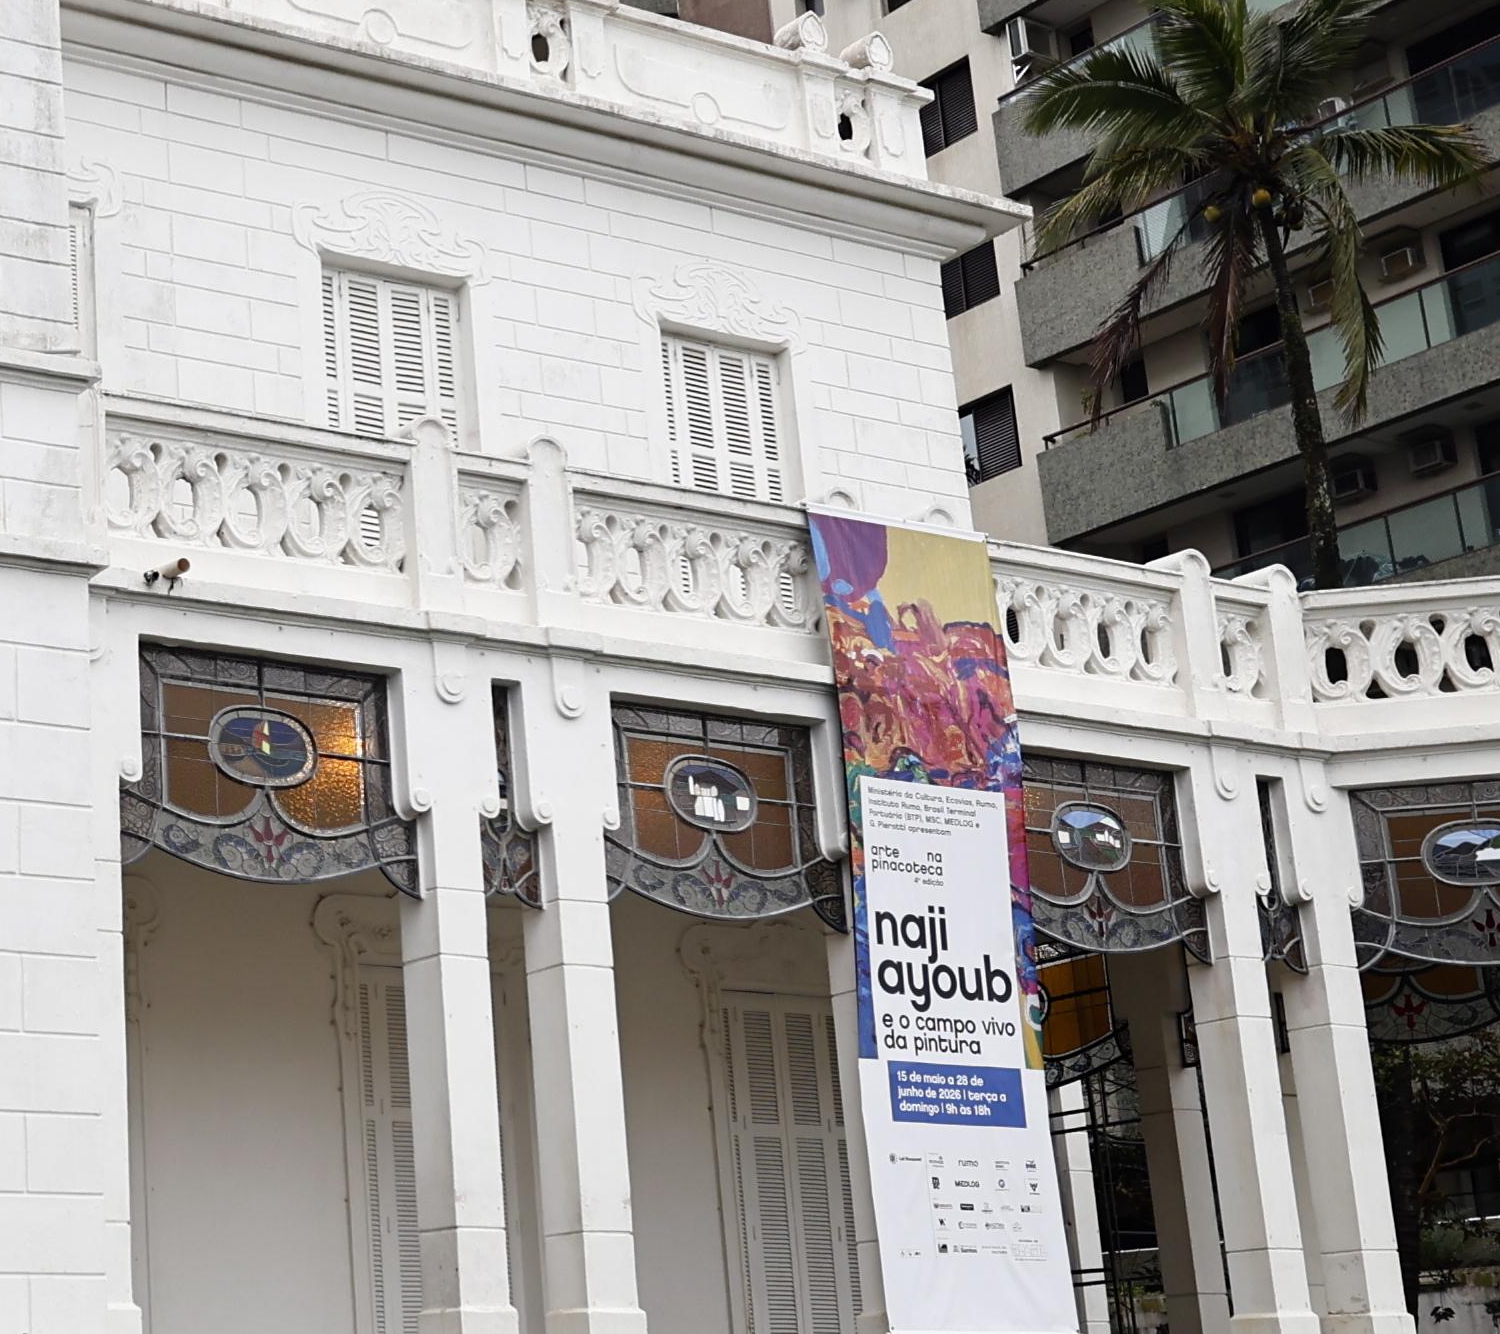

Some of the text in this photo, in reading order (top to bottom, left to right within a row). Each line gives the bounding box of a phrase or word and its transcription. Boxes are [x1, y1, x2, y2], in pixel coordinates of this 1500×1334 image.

[871, 845, 942, 863] arte na
[872, 856, 943, 876] pinacoteca
[875, 905, 948, 964] naji
[878, 955, 1012, 1012] ayoub
[882, 1013, 1015, 1038] e o campo vivo
[884, 1029, 981, 1056] da pintura
[897, 1070, 983, 1086] 15 de maio a 28 de
[898, 1086, 924, 1099] junho
[925, 1087, 936, 1098] de
[938, 1089, 961, 1099] 2026
[968, 1090, 998, 1103] terça
[1000, 1094, 1006, 1102] a
[900, 1101, 939, 1116] domingo
[945, 1104, 958, 1114] 9h
[960, 1103, 971, 1115] às
[974, 1105, 991, 1115] 18h
